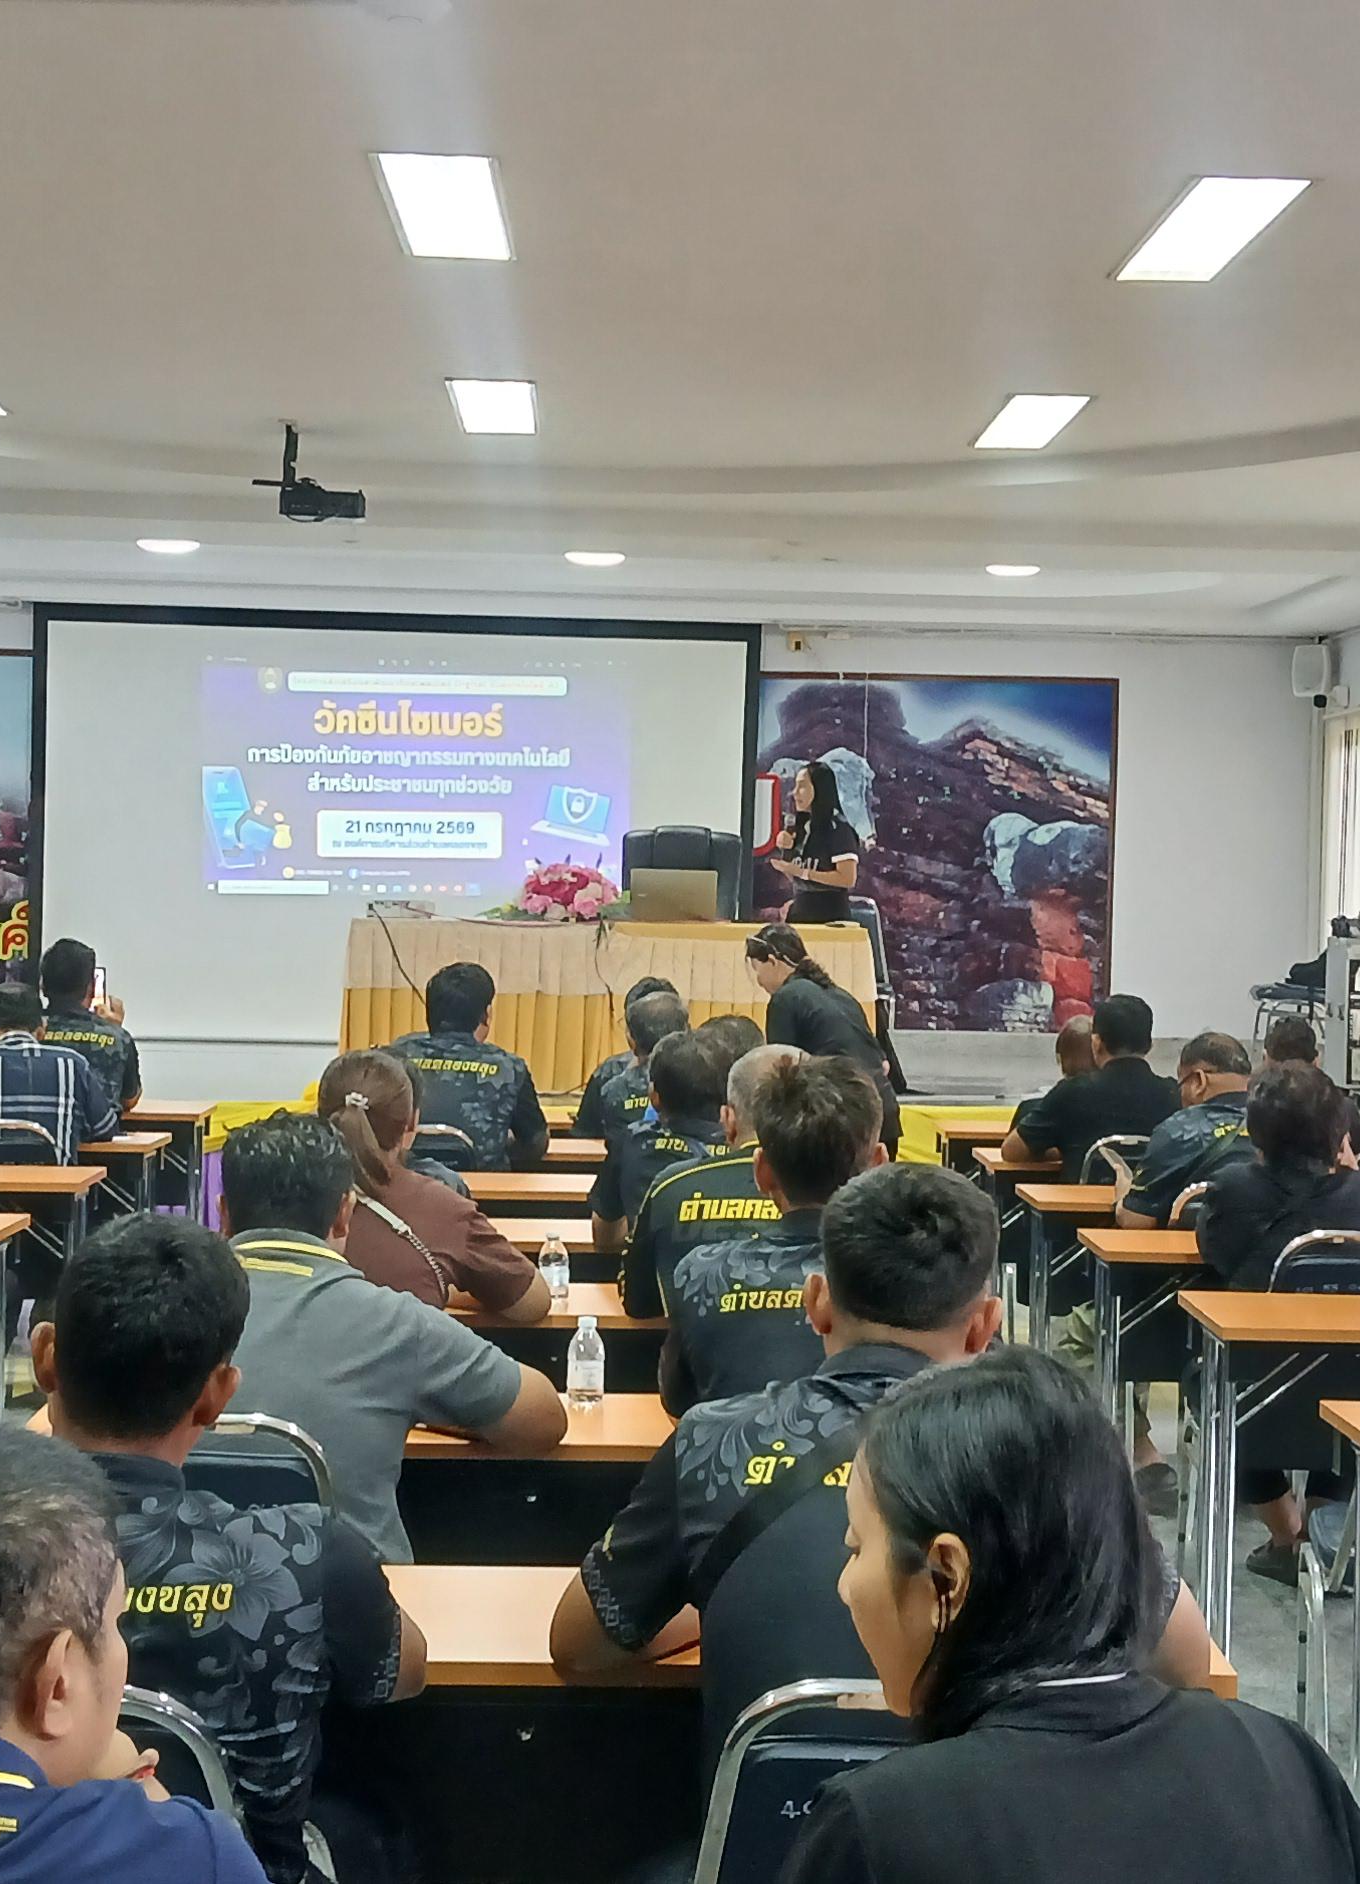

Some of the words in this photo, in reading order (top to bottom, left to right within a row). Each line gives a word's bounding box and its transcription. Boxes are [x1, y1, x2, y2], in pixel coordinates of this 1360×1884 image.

[314, 699, 503, 737] วัคซีนไซเบอร์
[247, 742, 571, 767] การป้องกันภัยอาชญากรรมทางเทคโนโลยี
[307, 770, 513, 798] สำหรับประชาชนทุกช่วงวัย
[345, 820, 361, 833] 21
[365, 821, 432, 837] กรกฎาคม
[436, 821, 475, 834] 2569
[679, 1192, 782, 1221] ตำบลคล
